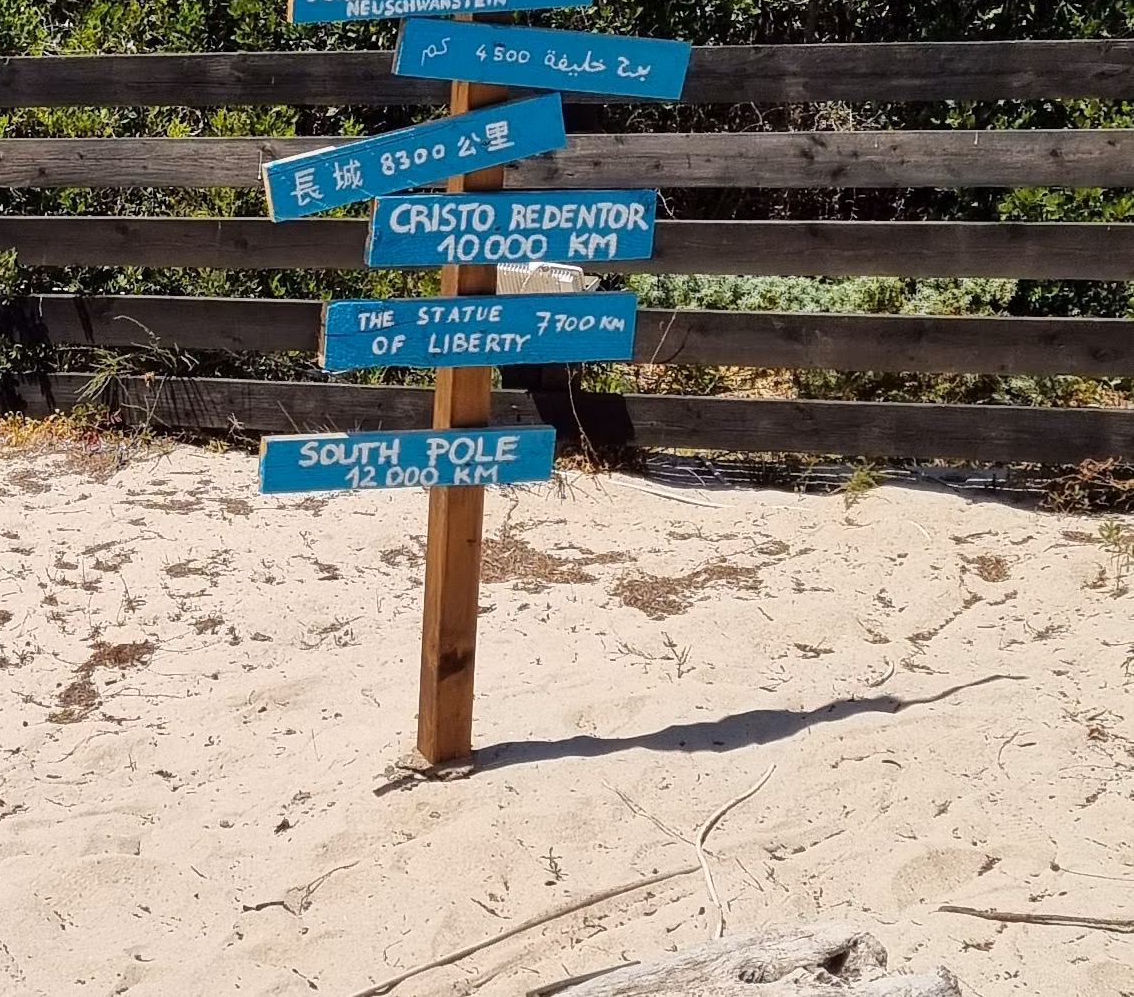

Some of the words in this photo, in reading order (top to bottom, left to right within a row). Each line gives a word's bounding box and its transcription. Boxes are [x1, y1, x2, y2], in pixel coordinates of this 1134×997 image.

[380, 144, 445, 176] 8300
[457, 120, 515, 157] 公里
[389, 202, 496, 234] CRISTO
[508, 202, 649, 231] REDENTOR
[568, 232, 618, 260] KM
[358, 310, 395, 330] THE
[416, 305, 503, 325] STATUE
[536, 311, 596, 336] 7700
[371, 334, 406, 355] OF
[428, 332, 531, 354] LIBERTY
[298, 440, 401, 467] SOUTH
[426, 435, 520, 466] POLE
[453, 462, 499, 487] KM
